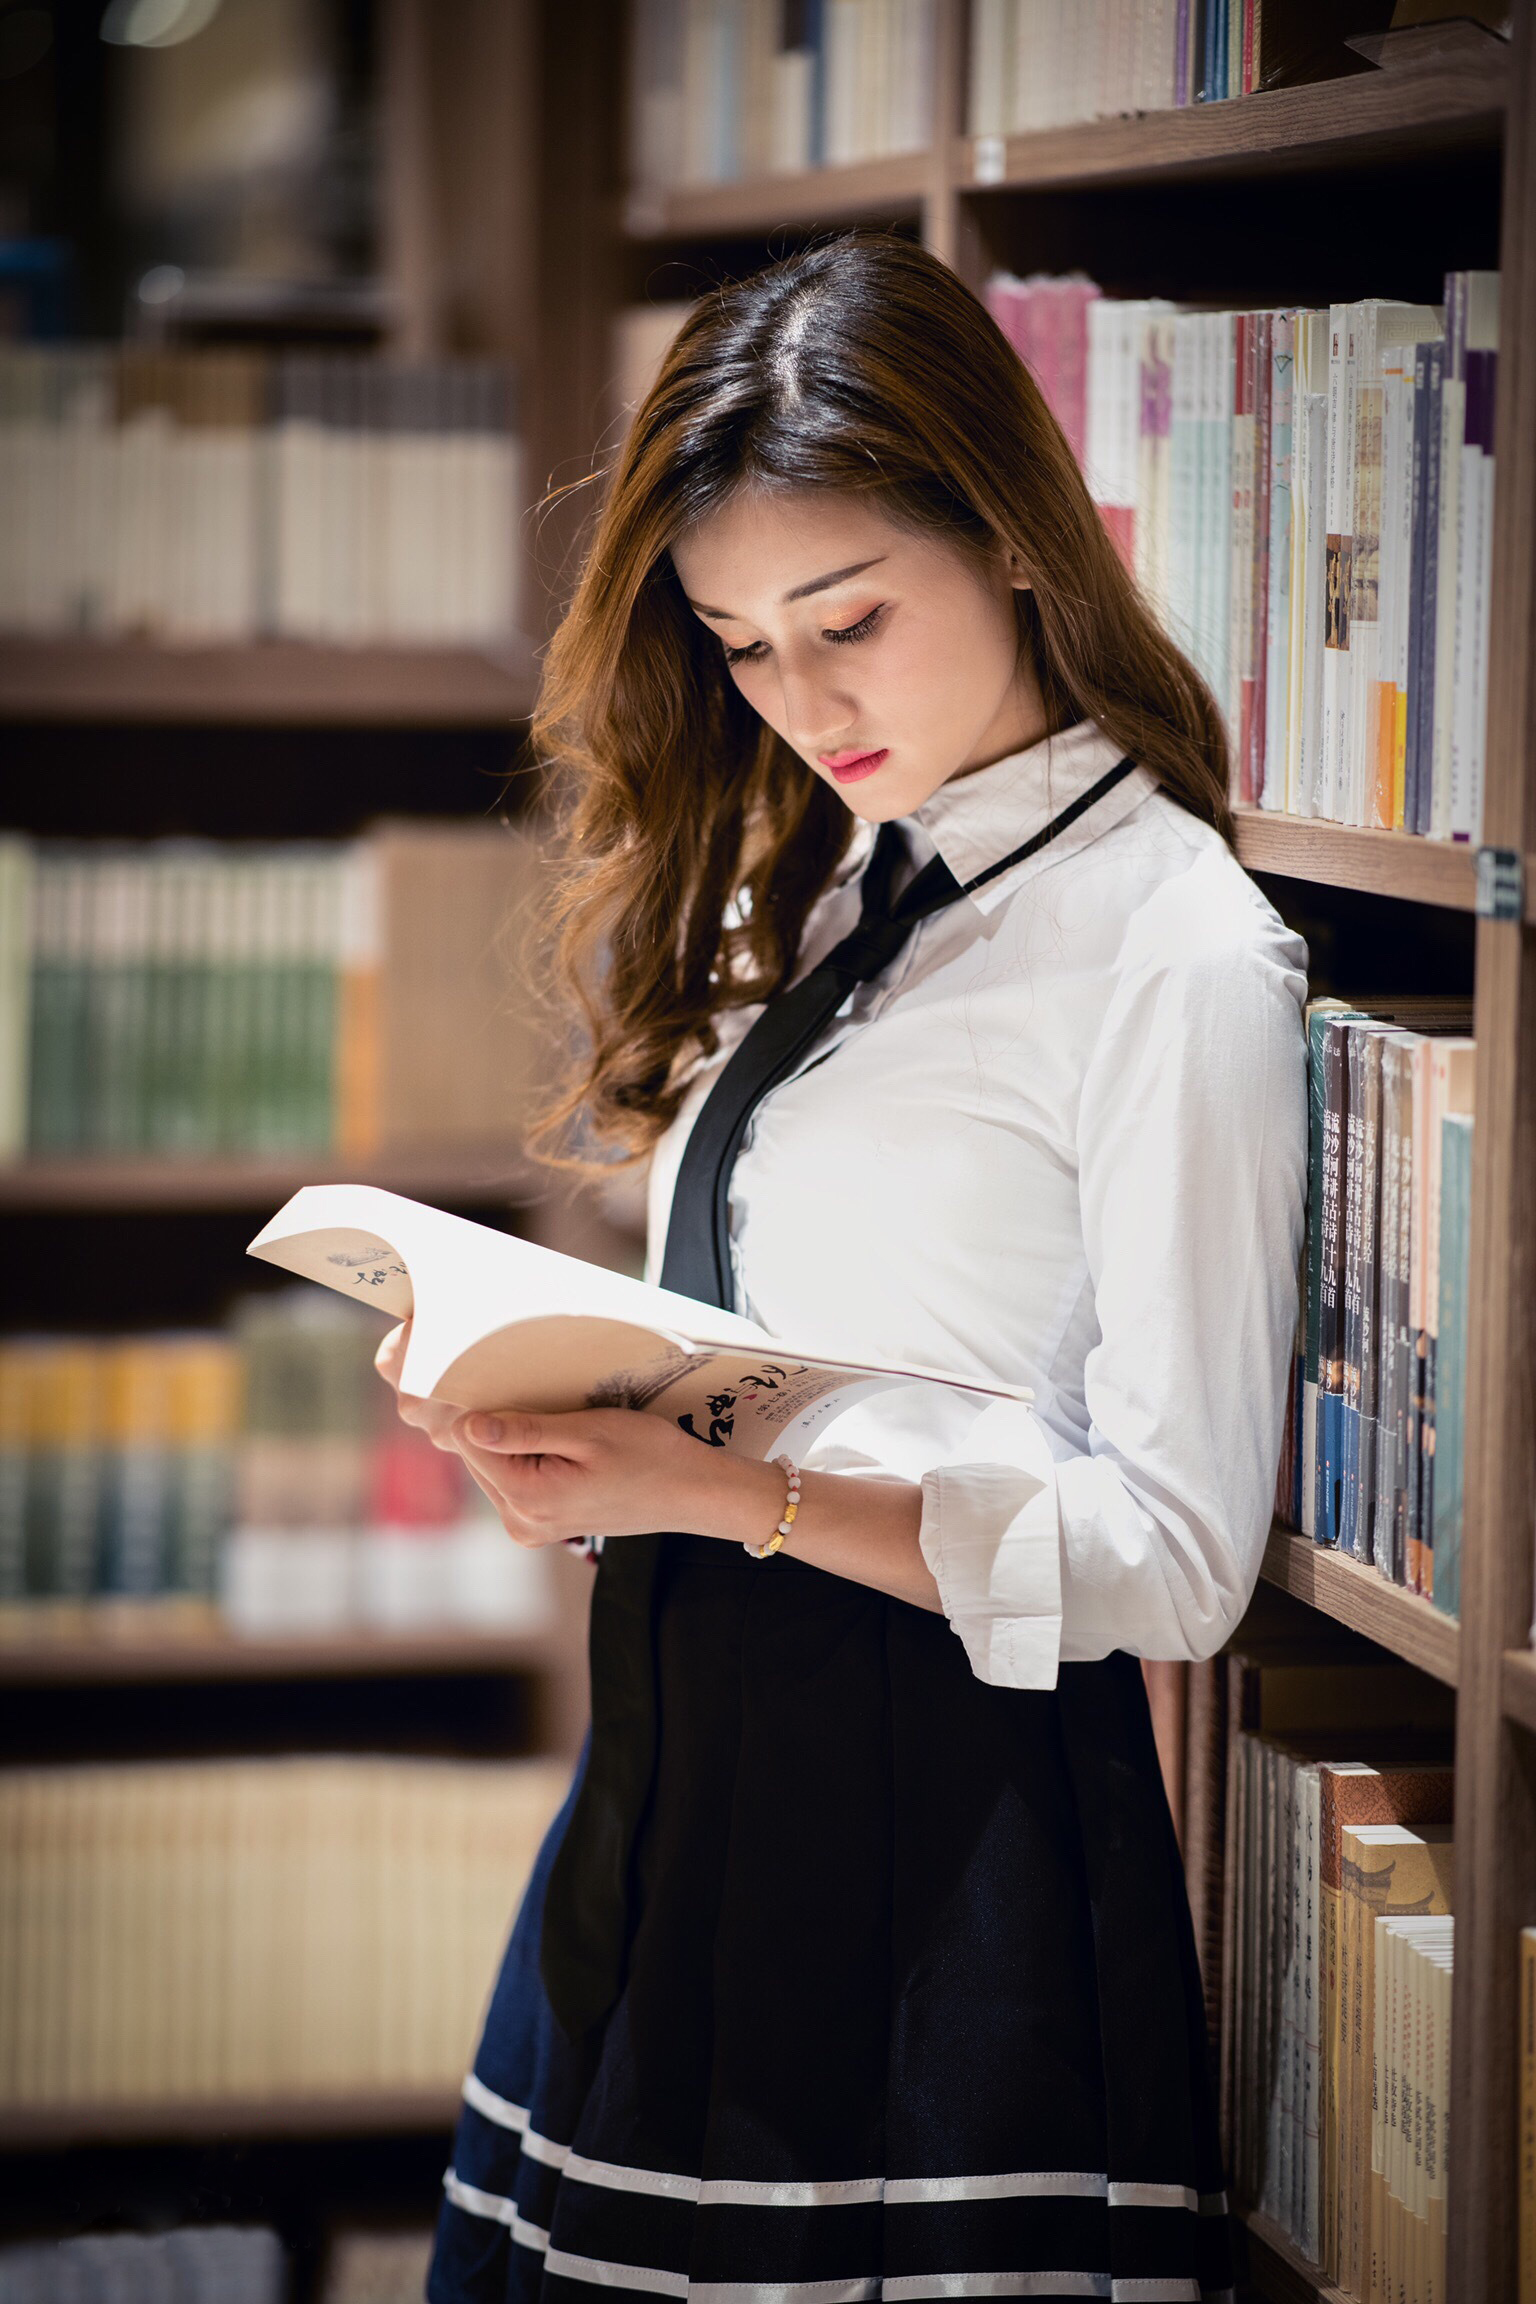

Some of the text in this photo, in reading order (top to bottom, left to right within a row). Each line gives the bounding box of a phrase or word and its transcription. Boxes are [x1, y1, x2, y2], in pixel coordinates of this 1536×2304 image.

[1320, 1108, 1331, 1304] 流沙河讲古诗十九首
[1327, 1112, 1340, 1309] 流沙河讲古诗十九首
[1344, 1113, 1355, 1310] 流沙河讲古诗十九首
[1352, 1118, 1364, 1316] 流沙河讲古诗十九首
